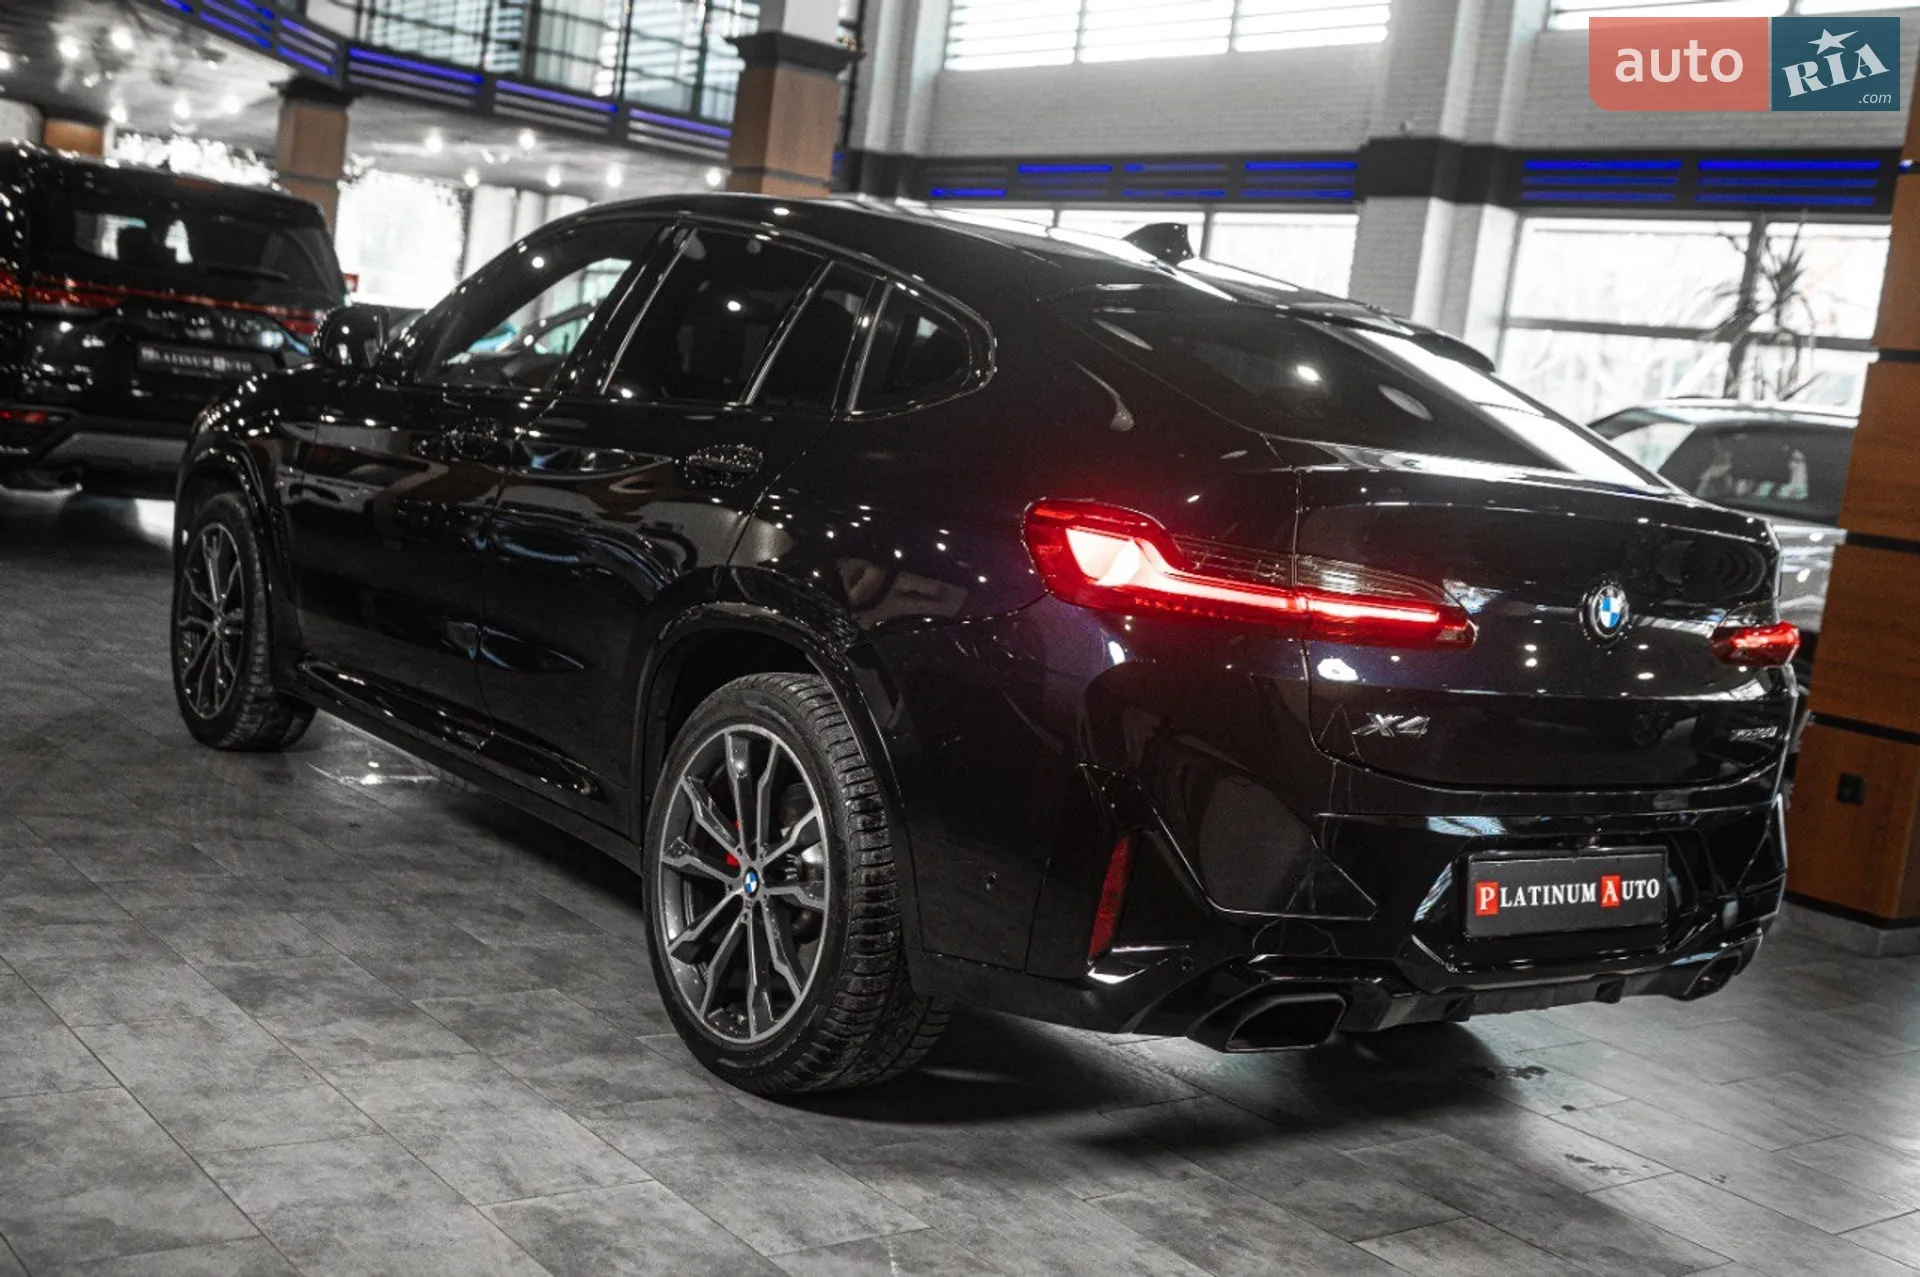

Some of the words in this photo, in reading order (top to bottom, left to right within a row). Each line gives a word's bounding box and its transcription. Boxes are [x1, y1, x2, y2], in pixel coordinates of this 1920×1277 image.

[1352, 712, 1431, 738] X4
[1478, 882, 1597, 911] PLATINUM
[1602, 878, 1661, 904] AUTO
